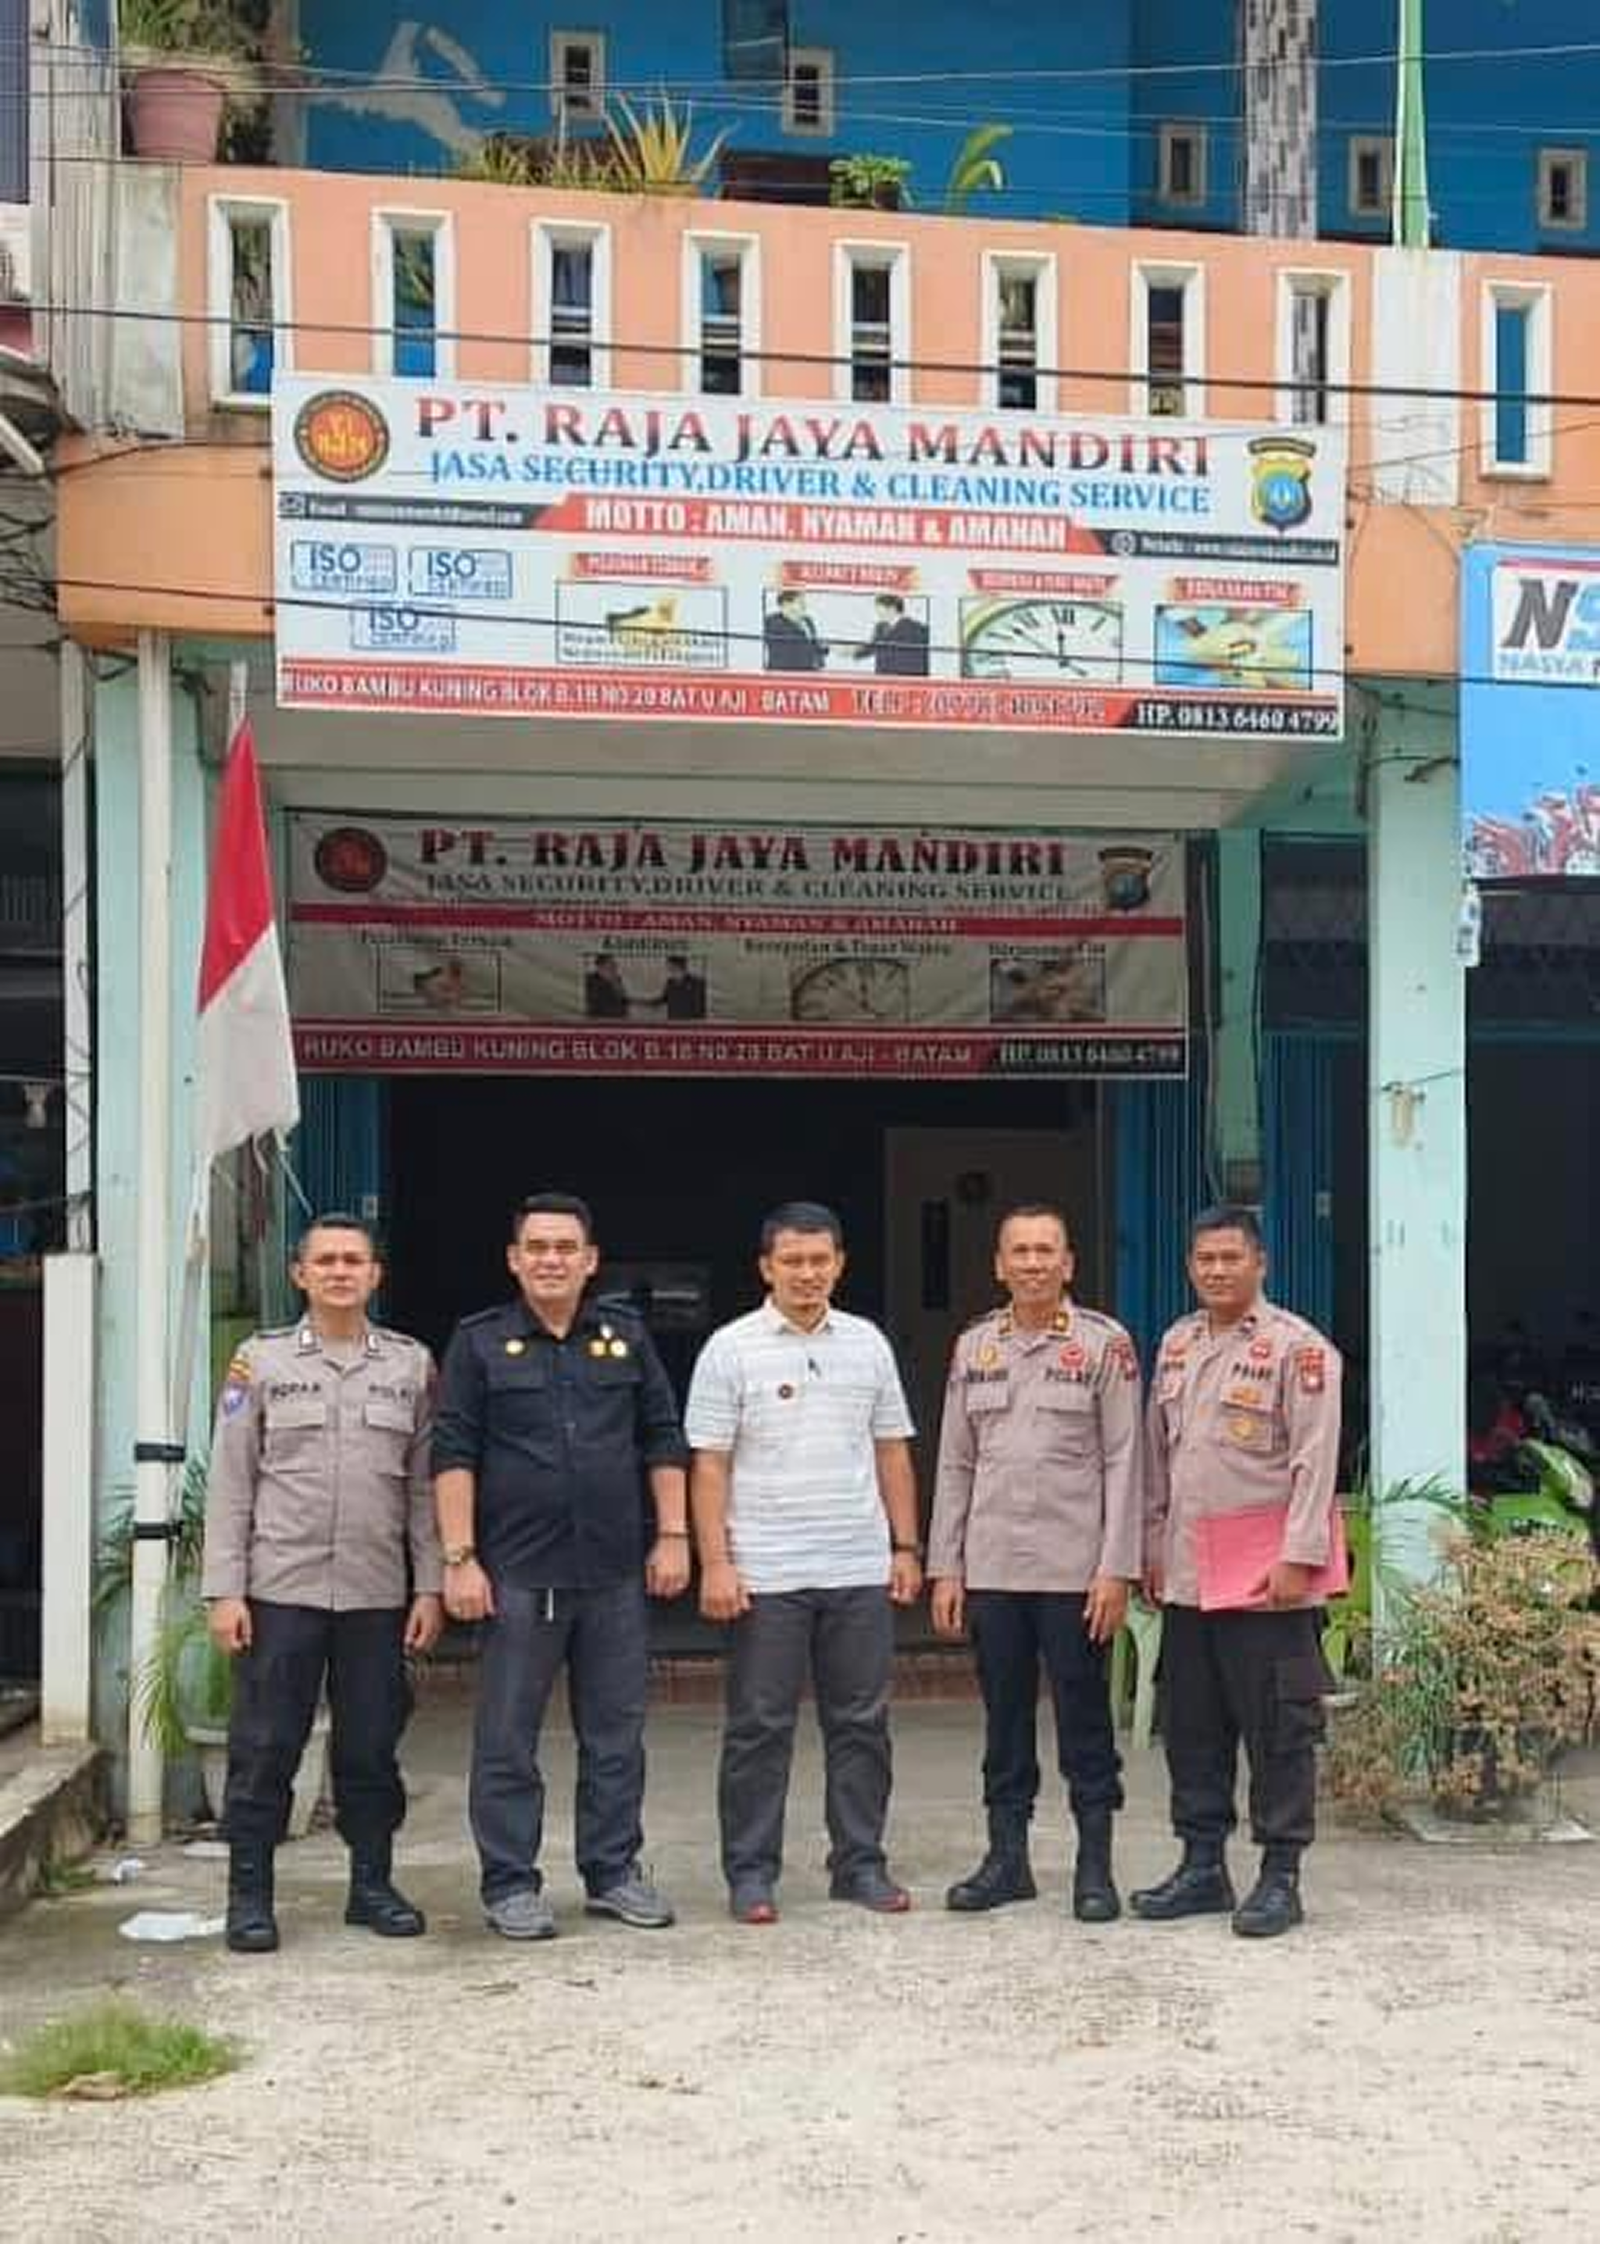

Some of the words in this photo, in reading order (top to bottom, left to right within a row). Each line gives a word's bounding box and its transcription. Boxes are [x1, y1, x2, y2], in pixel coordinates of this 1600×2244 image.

[415, 397, 518, 442] PT.
[544, 403, 712, 458] RAJA
[734, 413, 883, 462] JAYA
[906, 422, 1208, 476] MANDIRI
[431, 451, 511, 483] JASA
[851, 472, 877, 497] &
[887, 473, 1061, 507] CLEANING
[1069, 481, 1212, 514] SERVICE
[586, 500, 686, 531] MOTTO
[922, 518, 944, 543] &
[310, 545, 362, 573] ISO
[427, 551, 478, 578] ISO
[369, 606, 420, 631] ISO
[761, 689, 829, 714] BATAM
[419, 828, 507, 866] PT.
[532, 829, 667, 872] RAJA
[689, 834, 810, 874] JAYA
[830, 836, 1065, 876] MANDIRI
[426, 873, 492, 894] JASA
[771, 879, 795, 898] &
[803, 877, 947, 900] CLEANING
[303, 1034, 371, 1059] RUKO
[472, 1036, 565, 1061] KUNING
